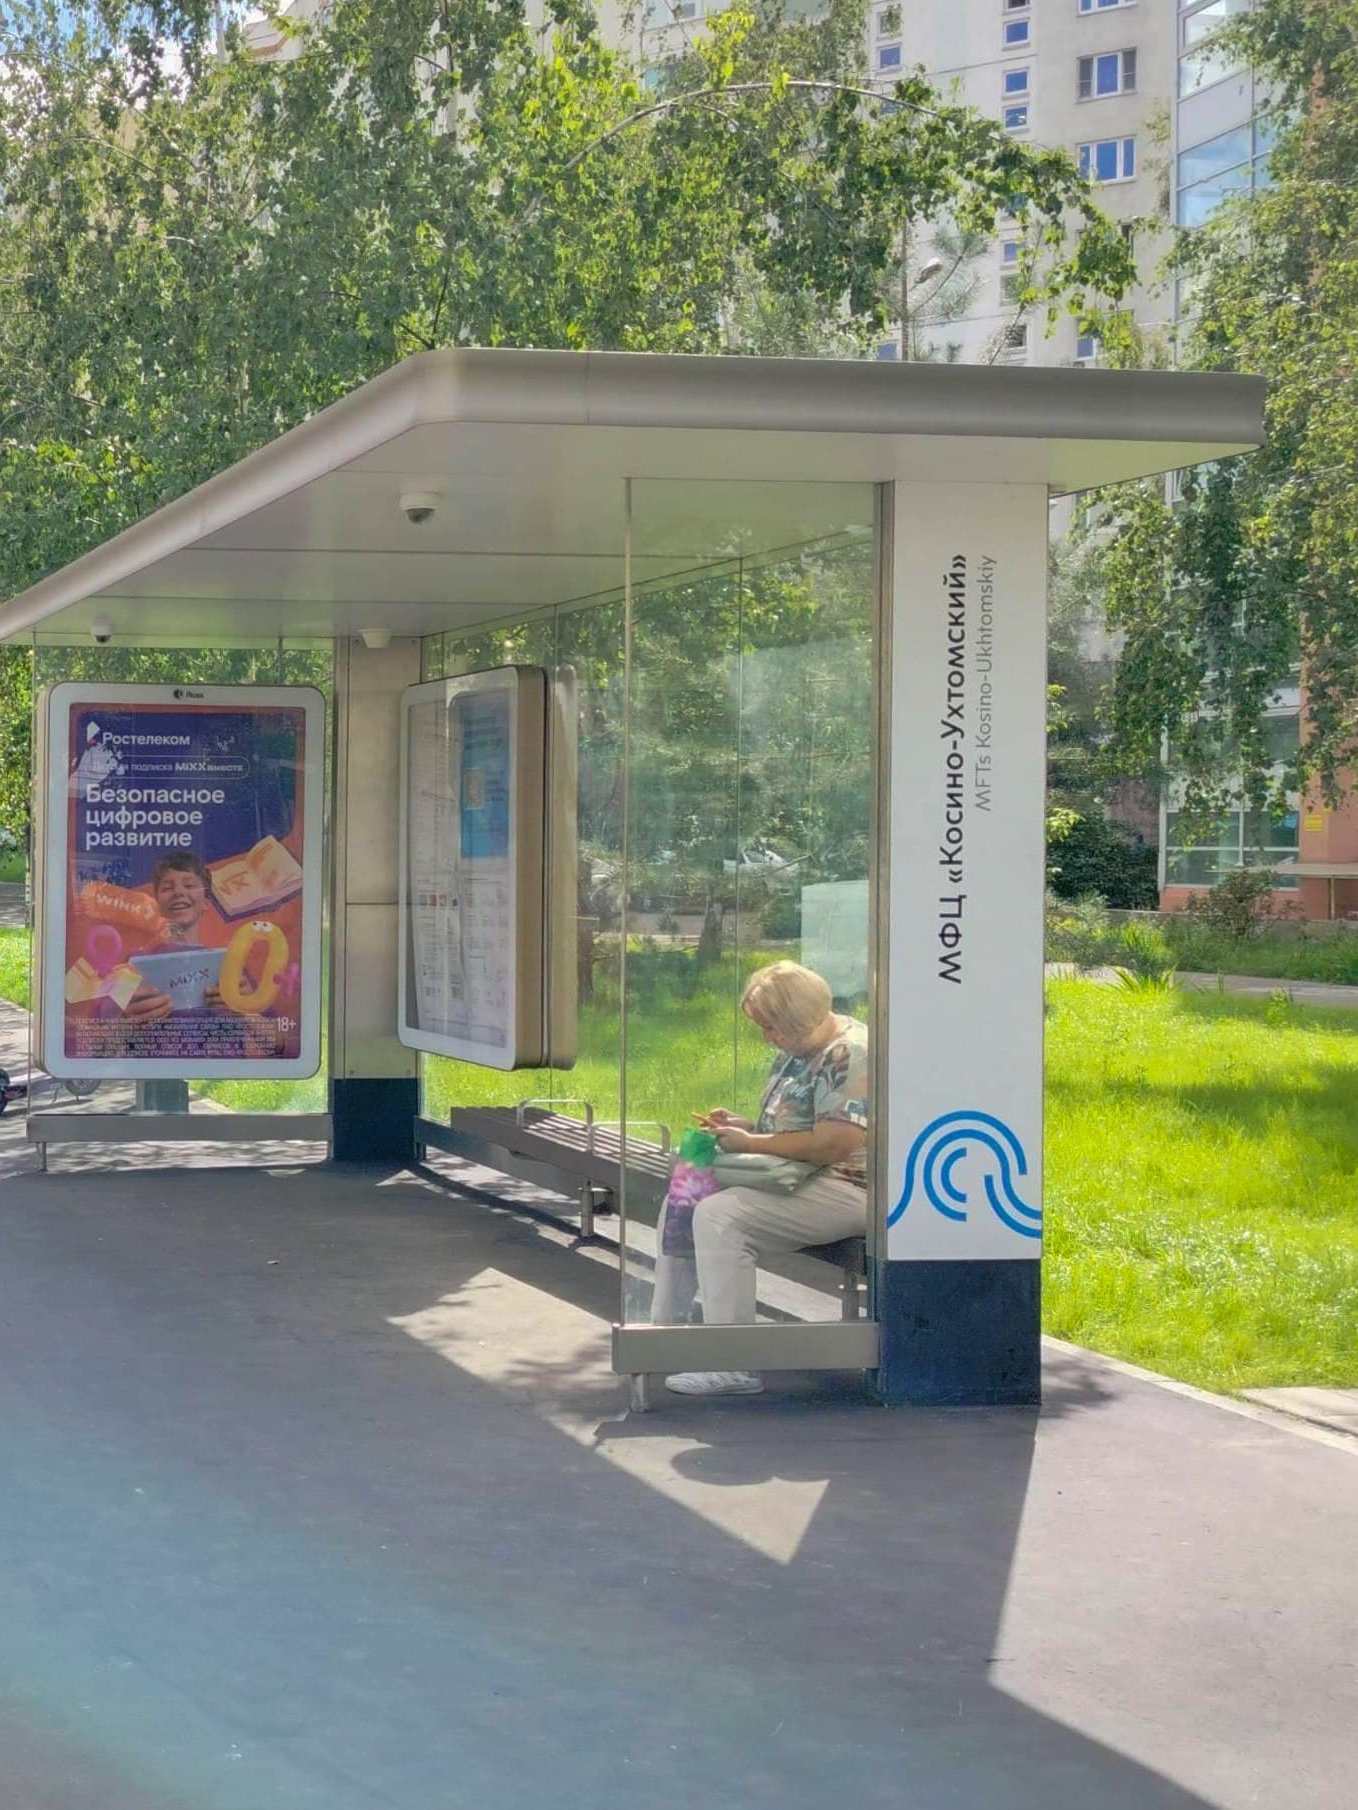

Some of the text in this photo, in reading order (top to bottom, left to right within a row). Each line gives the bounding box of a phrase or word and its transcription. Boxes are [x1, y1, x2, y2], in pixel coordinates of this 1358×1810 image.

[975, 554, 997, 812] MFTs Kosino-Ukhtomskiy
[102, 731, 191, 746] Ростелеком
[938, 553, 968, 984] МФЦ «Косино-Ухтомский»
[86, 783, 225, 804] Безопасное
[86, 806, 203, 829] цифровое
[86, 831, 192, 850] развитие
[277, 1016, 297, 1032] 18+
